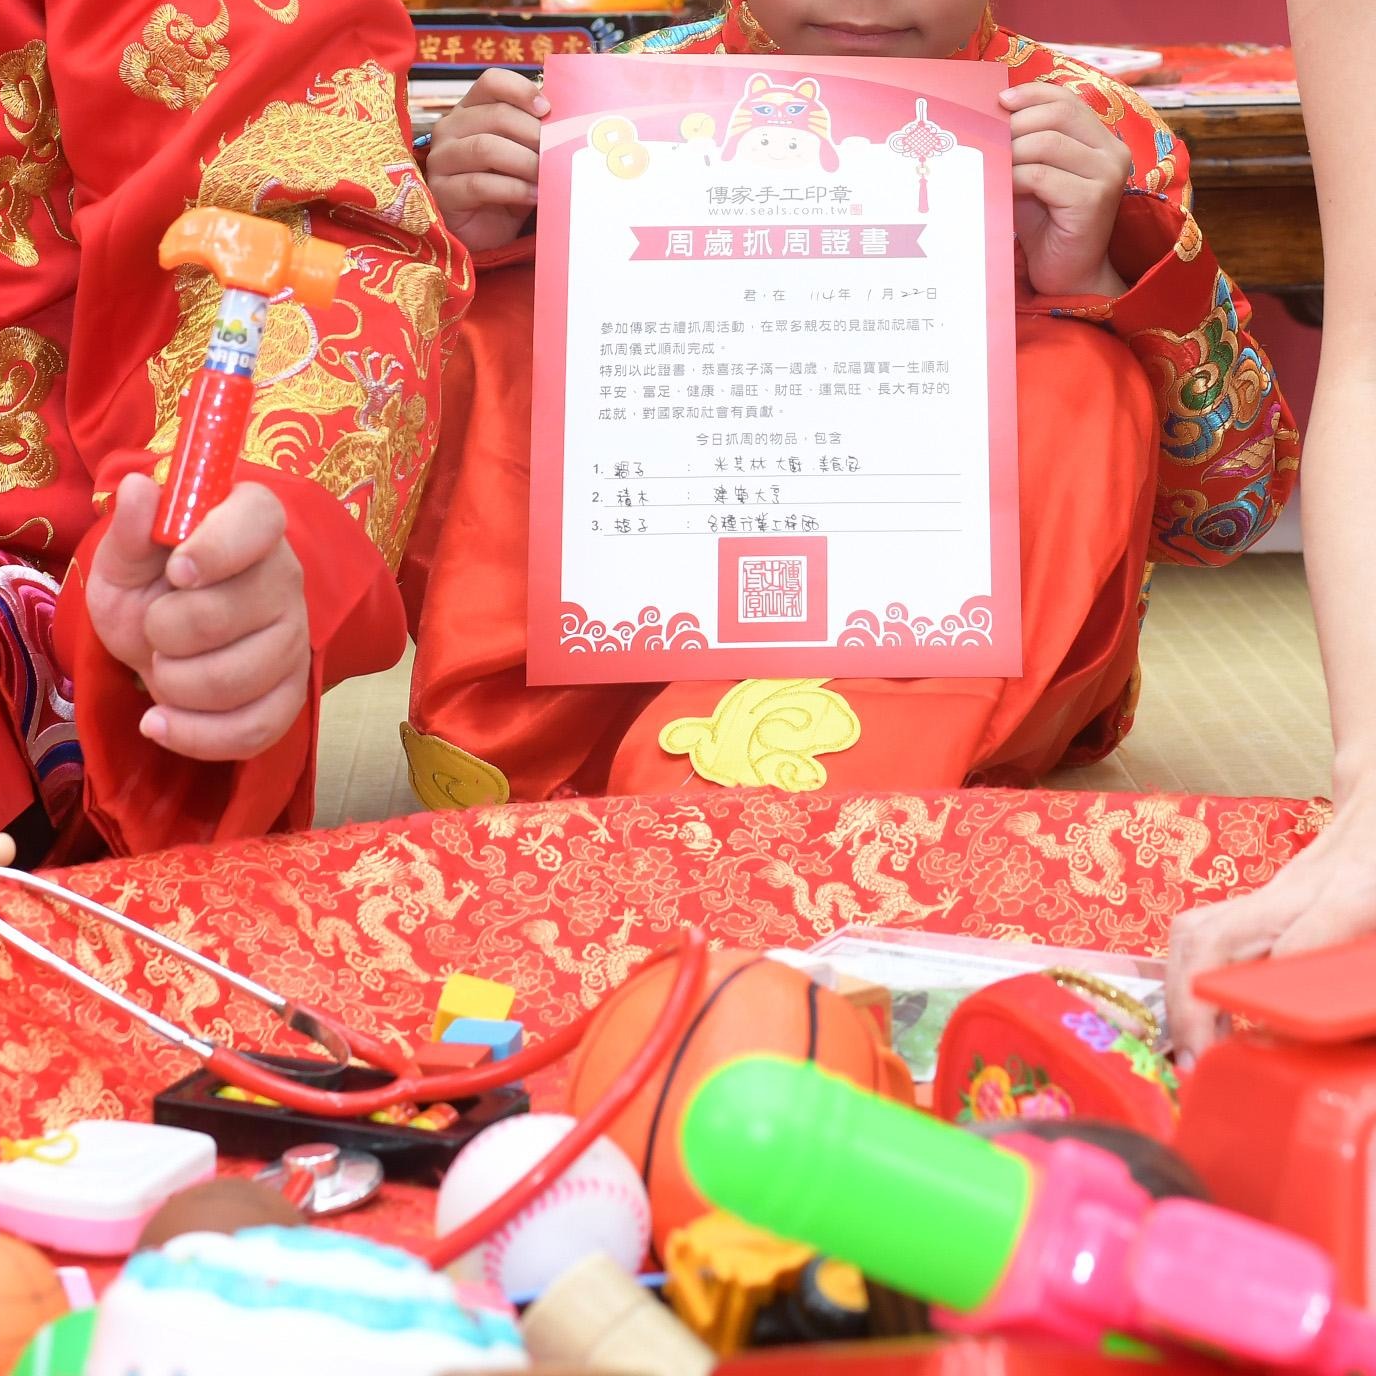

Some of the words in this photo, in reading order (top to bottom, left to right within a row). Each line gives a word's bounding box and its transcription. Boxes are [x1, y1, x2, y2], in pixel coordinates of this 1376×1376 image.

[705, 185, 853, 204] 傳家手工印章
[708, 205, 848, 216] www.seals.com.tw
[664, 228, 890, 257] 周歲抓周證書
